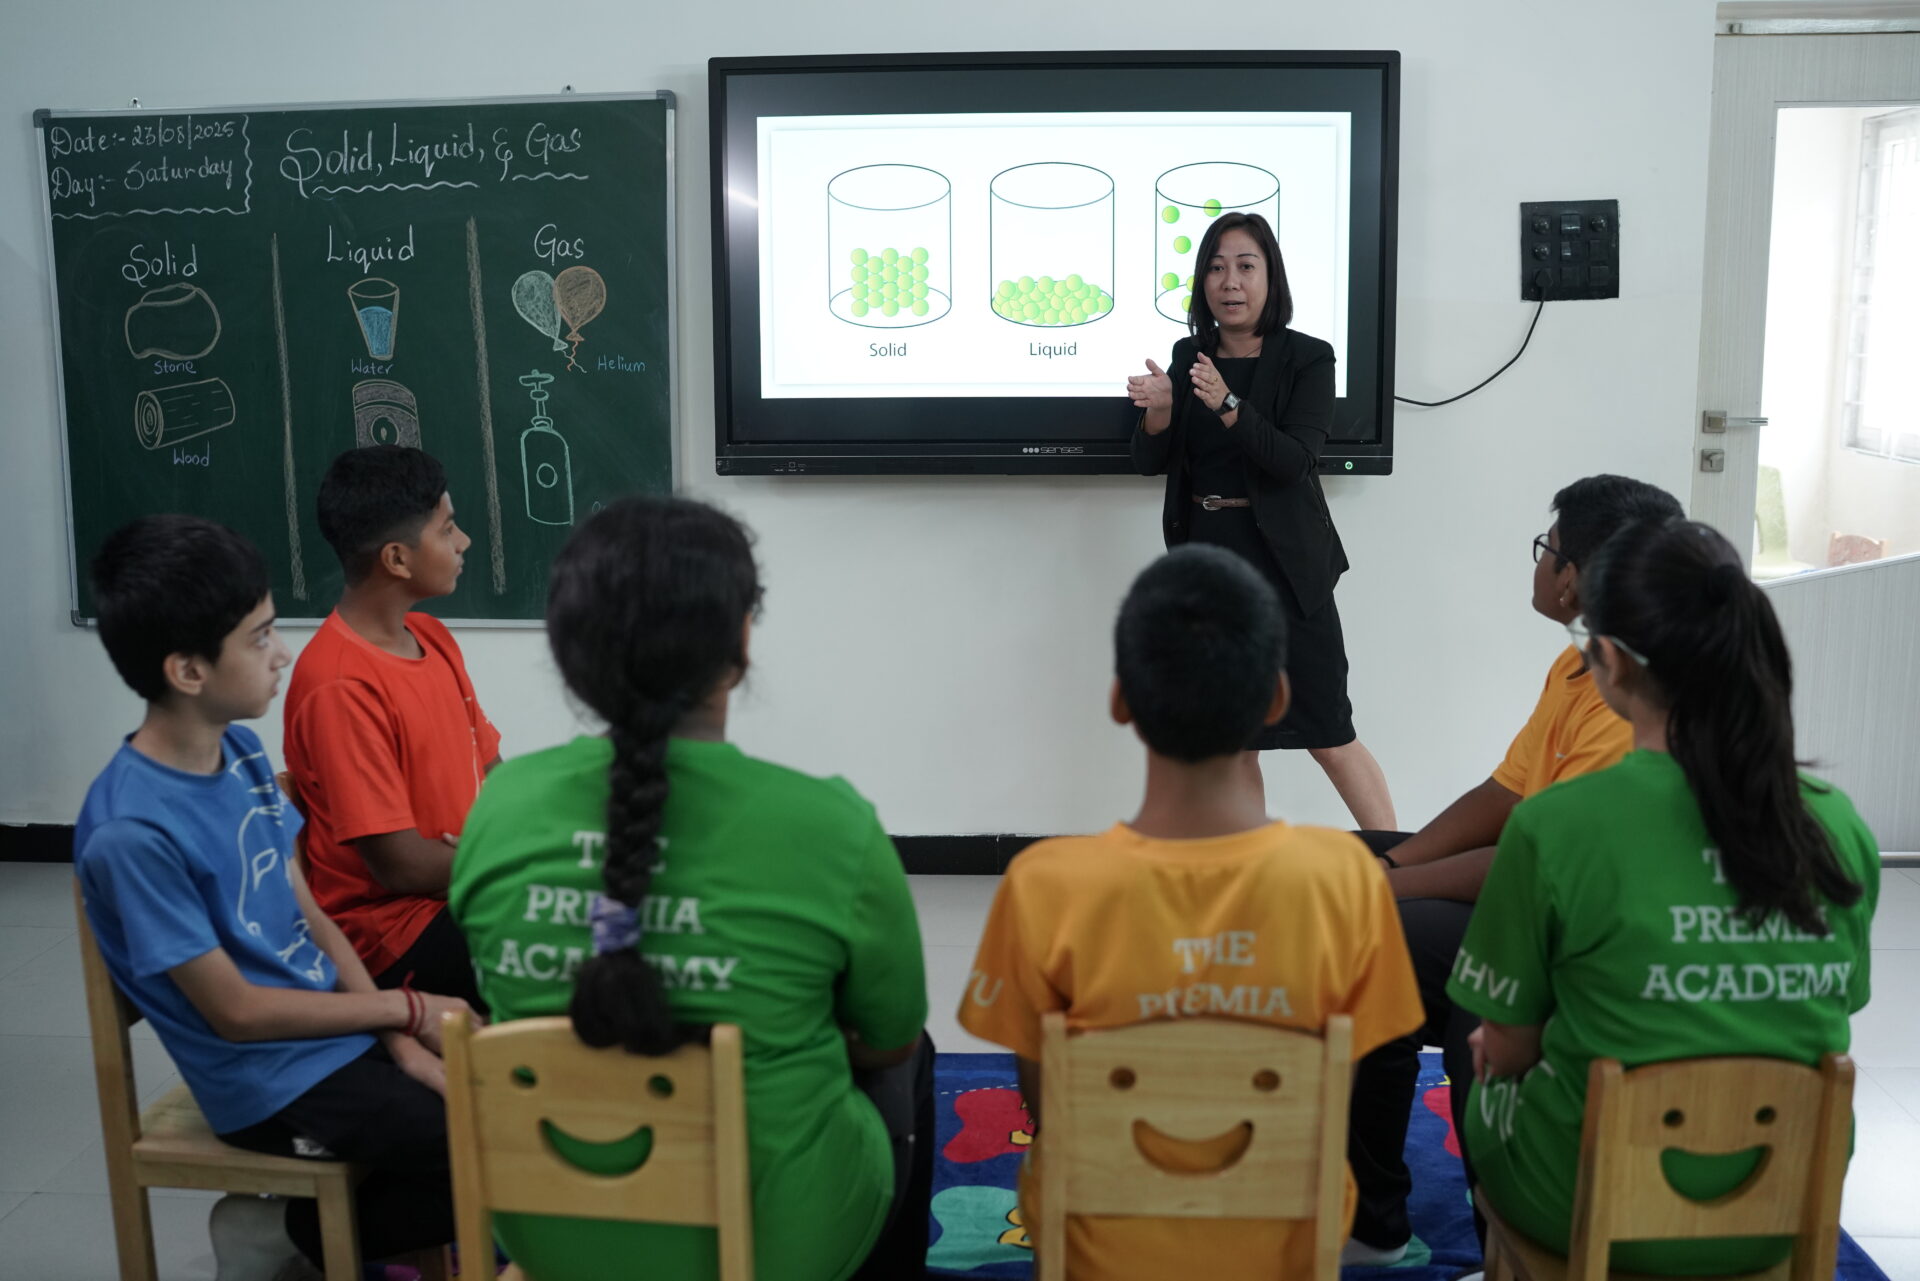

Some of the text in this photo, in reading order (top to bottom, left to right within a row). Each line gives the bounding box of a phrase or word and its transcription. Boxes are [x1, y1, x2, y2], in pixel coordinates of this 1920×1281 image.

[124, 156, 233, 190] Saturday
[280, 127, 383, 199] Solid,
[390, 122, 485, 178] Liquid,
[525, 122, 582, 166] Gas
[327, 224, 415, 274] Liquid
[533, 223, 585, 266] Gas
[121, 240, 198, 288] Solid
[597, 355, 646, 373] Helium
[869, 342, 908, 357] Solid
[1029, 342, 1078, 359] Liquid
[154, 360, 197, 375] Stone
[351, 359, 394, 375] Water
[173, 441, 211, 467] Wood
[1641, 961, 1852, 1002] ACADEMY
